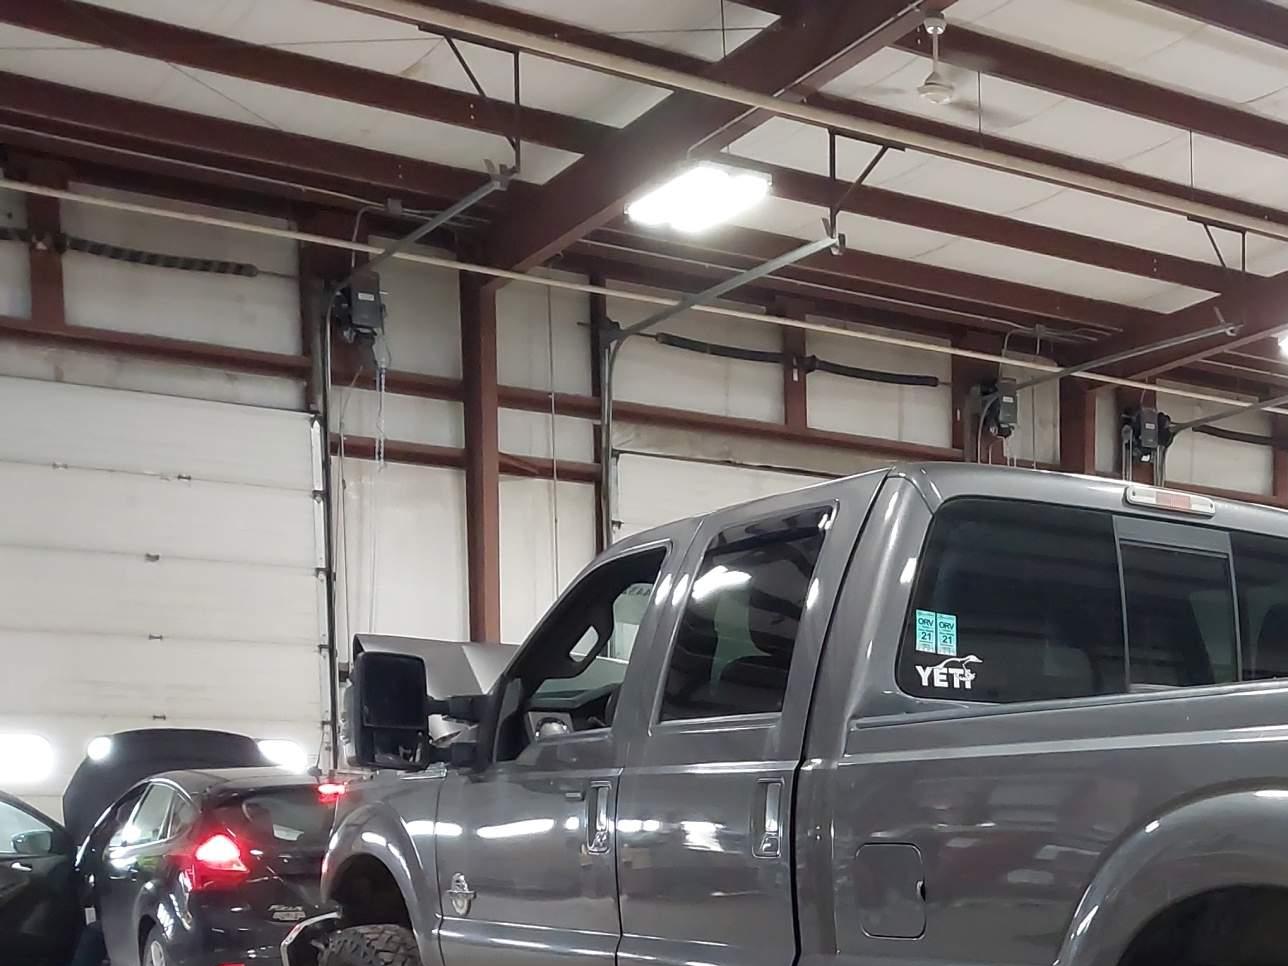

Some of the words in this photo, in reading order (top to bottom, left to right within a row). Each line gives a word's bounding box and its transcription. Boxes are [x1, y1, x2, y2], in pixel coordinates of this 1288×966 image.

[918, 618, 934, 626] ORV
[939, 621, 954, 630] ORV
[921, 632, 931, 641] 21
[942, 635, 952, 644] 21
[915, 665, 973, 690] YETI
